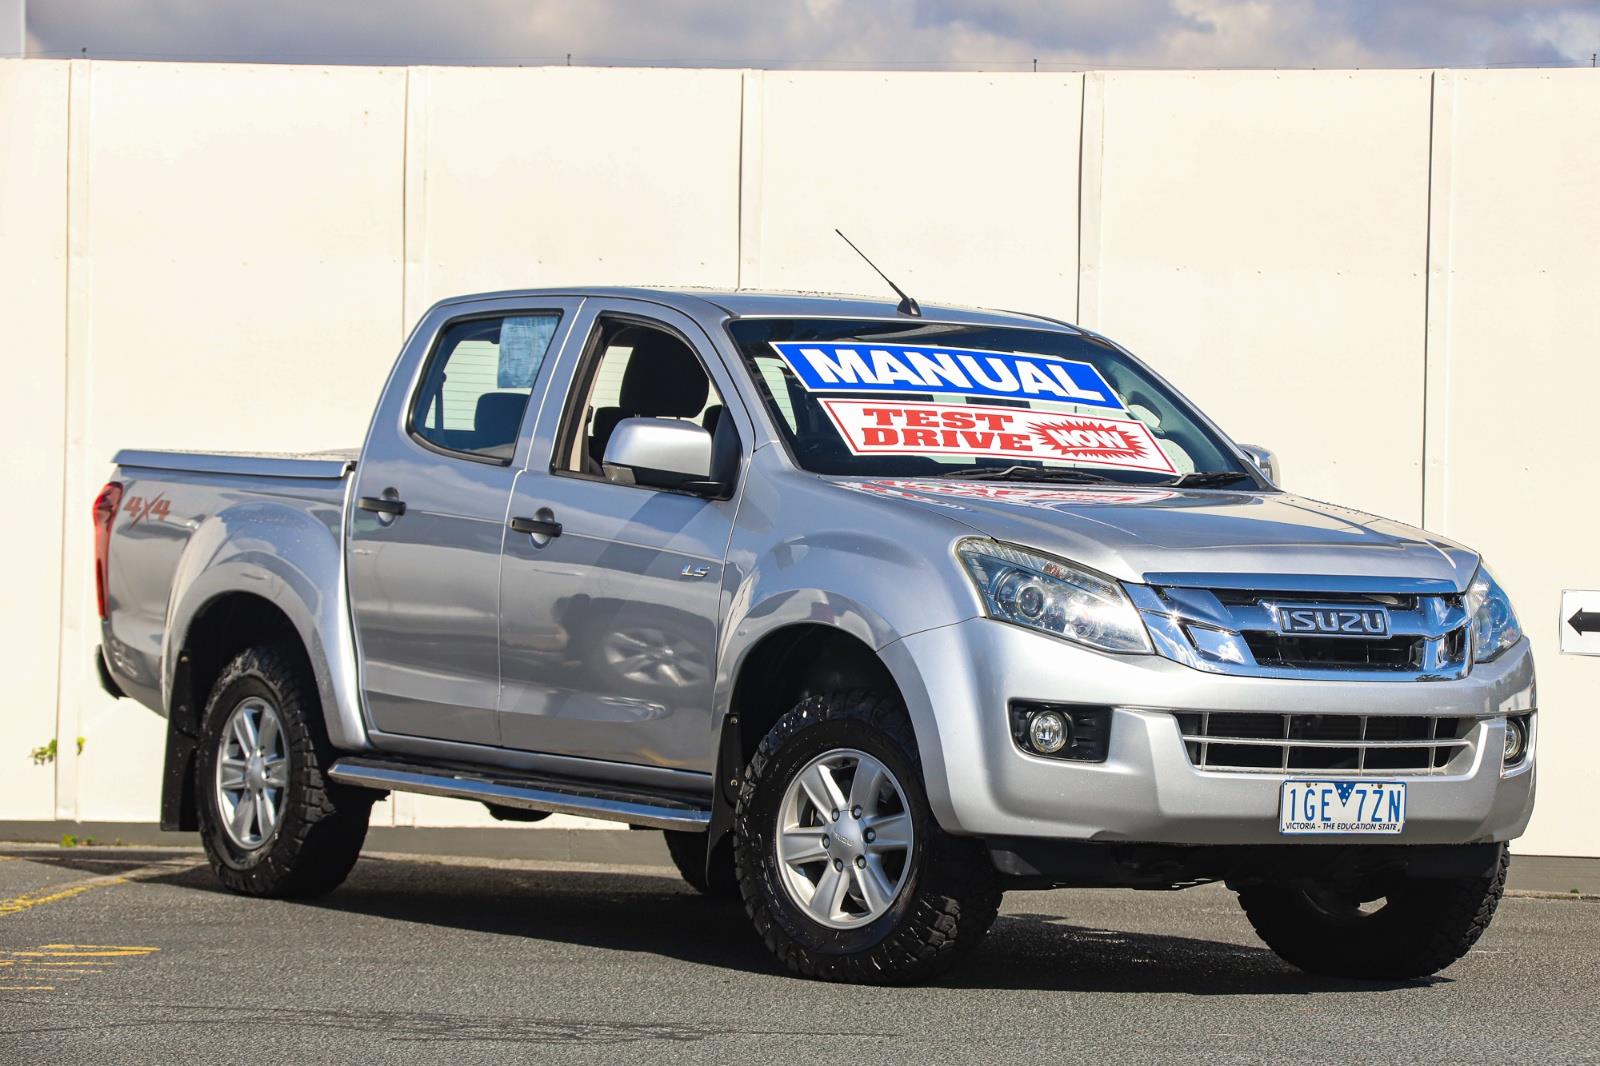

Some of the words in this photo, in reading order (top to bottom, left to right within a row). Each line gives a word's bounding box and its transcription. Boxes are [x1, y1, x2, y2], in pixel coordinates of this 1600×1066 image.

[799, 348, 1107, 402] MANUAL
[862, 407, 1014, 432] TEST
[862, 427, 1033, 453] DRIVE
[1050, 427, 1132, 451] NOW
[1280, 610, 1385, 633] ISUZU
[1290, 788, 1333, 822] 1GE
[1355, 789, 1401, 822] 7ZN
[1286, 822, 1316, 830] VICTORIA
[1337, 823, 1377, 831] EDUCATION
[1378, 823, 1398, 831] STATE
